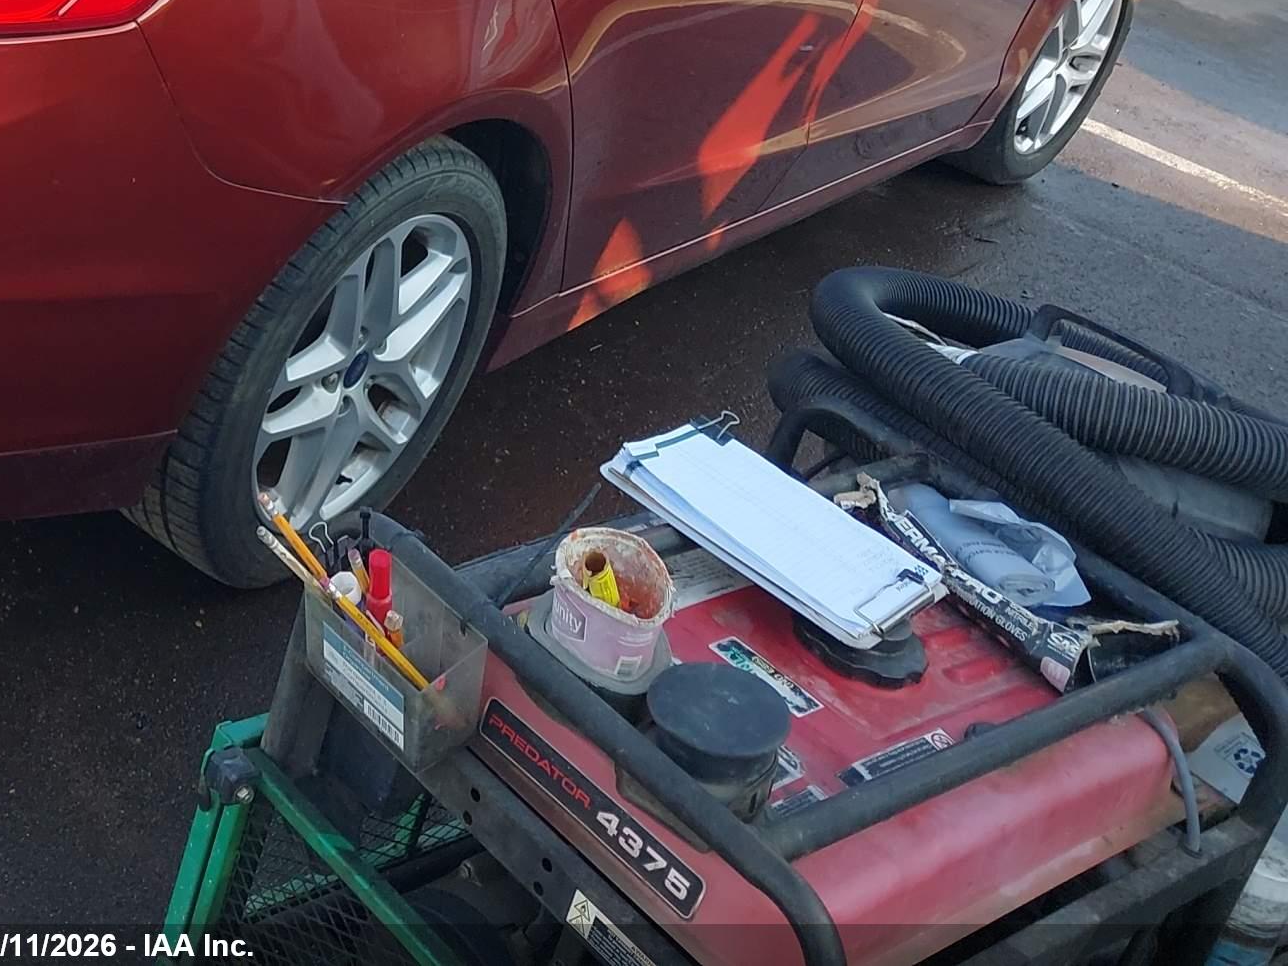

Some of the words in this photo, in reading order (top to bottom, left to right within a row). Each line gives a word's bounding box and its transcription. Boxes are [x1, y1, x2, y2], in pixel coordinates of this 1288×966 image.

[994, 615, 1027, 642] GLOVES
[488, 714, 591, 810] PREDATOR
[596, 811, 691, 901] 4375
